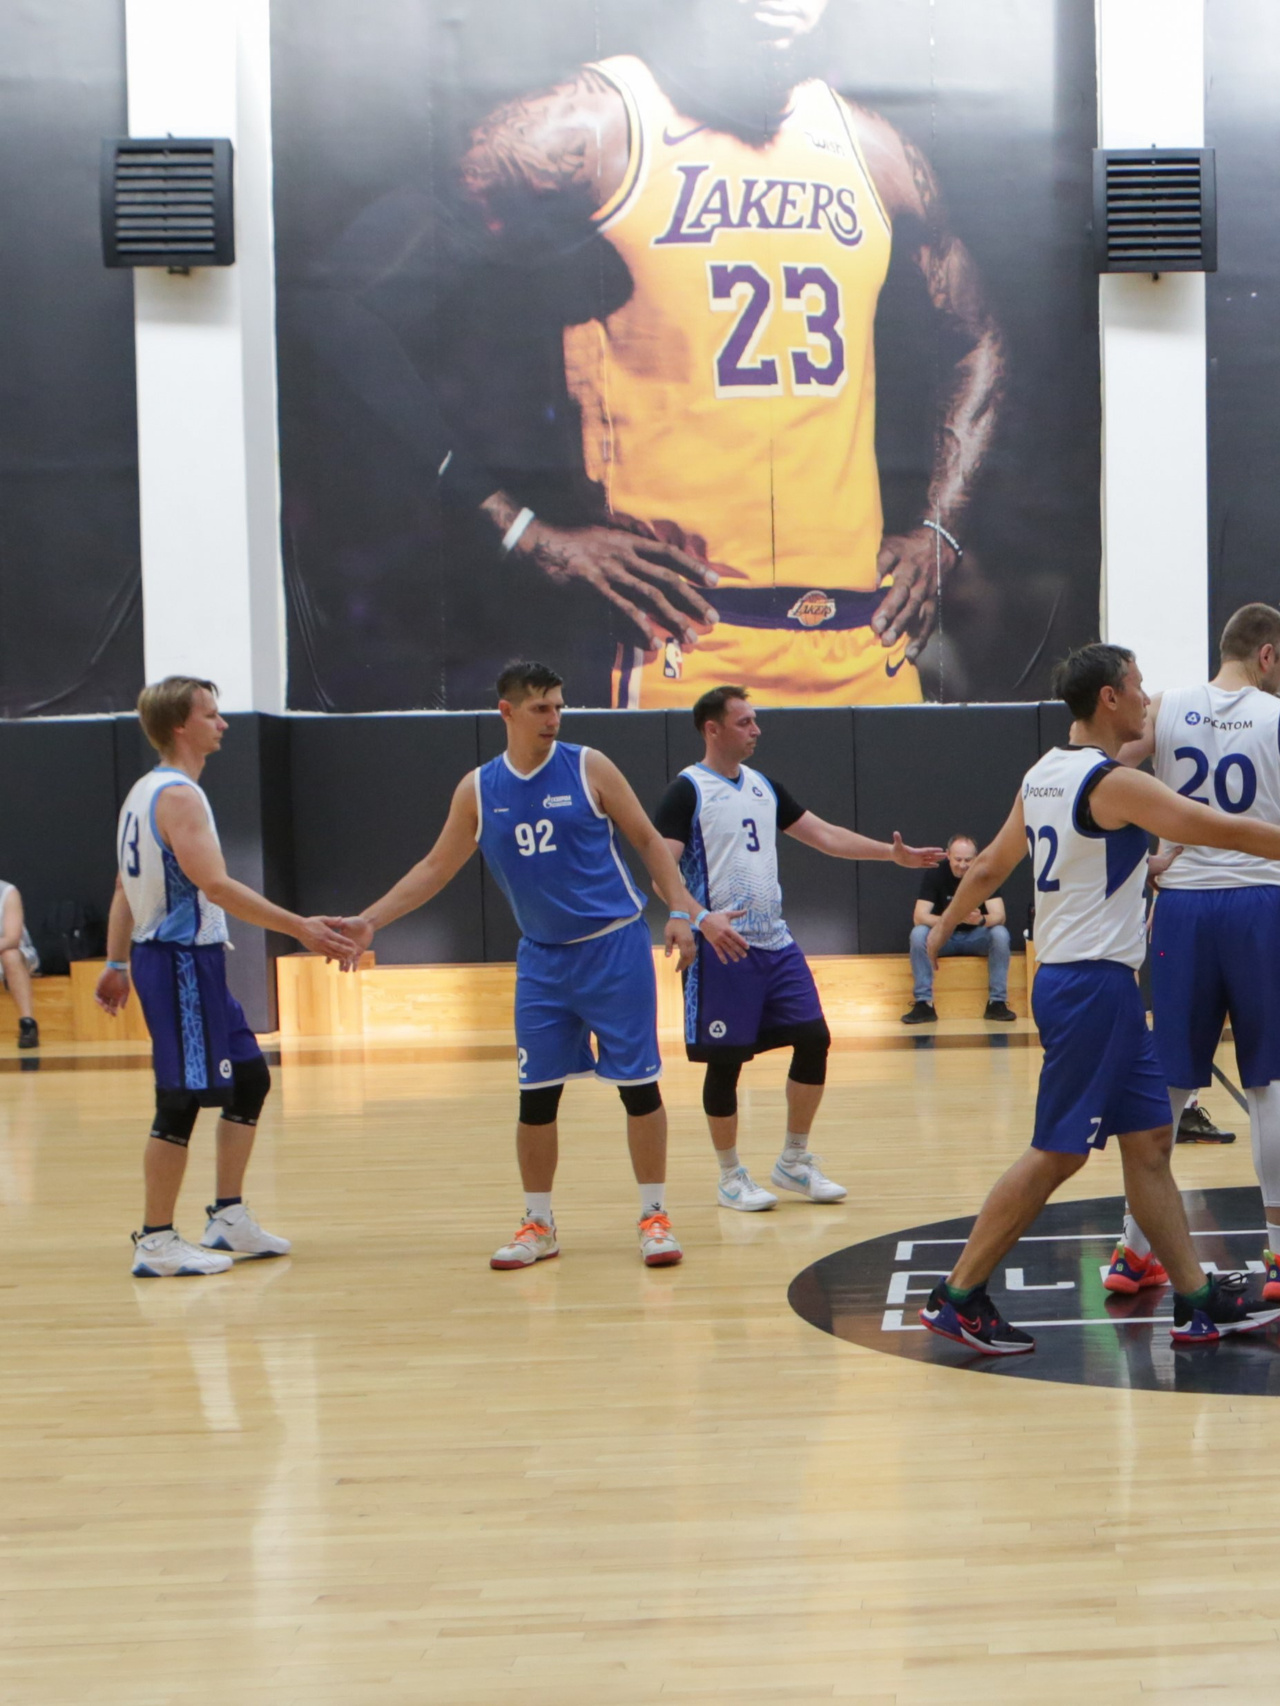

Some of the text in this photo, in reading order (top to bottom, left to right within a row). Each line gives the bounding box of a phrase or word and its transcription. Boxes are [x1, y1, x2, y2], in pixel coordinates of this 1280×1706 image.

[652, 164, 864, 247] LAKERS
[707, 261, 848, 398] 23
[1173, 746, 1258, 814] 20
[514, 818, 558, 857] 92
[741, 817, 760, 853] 3
